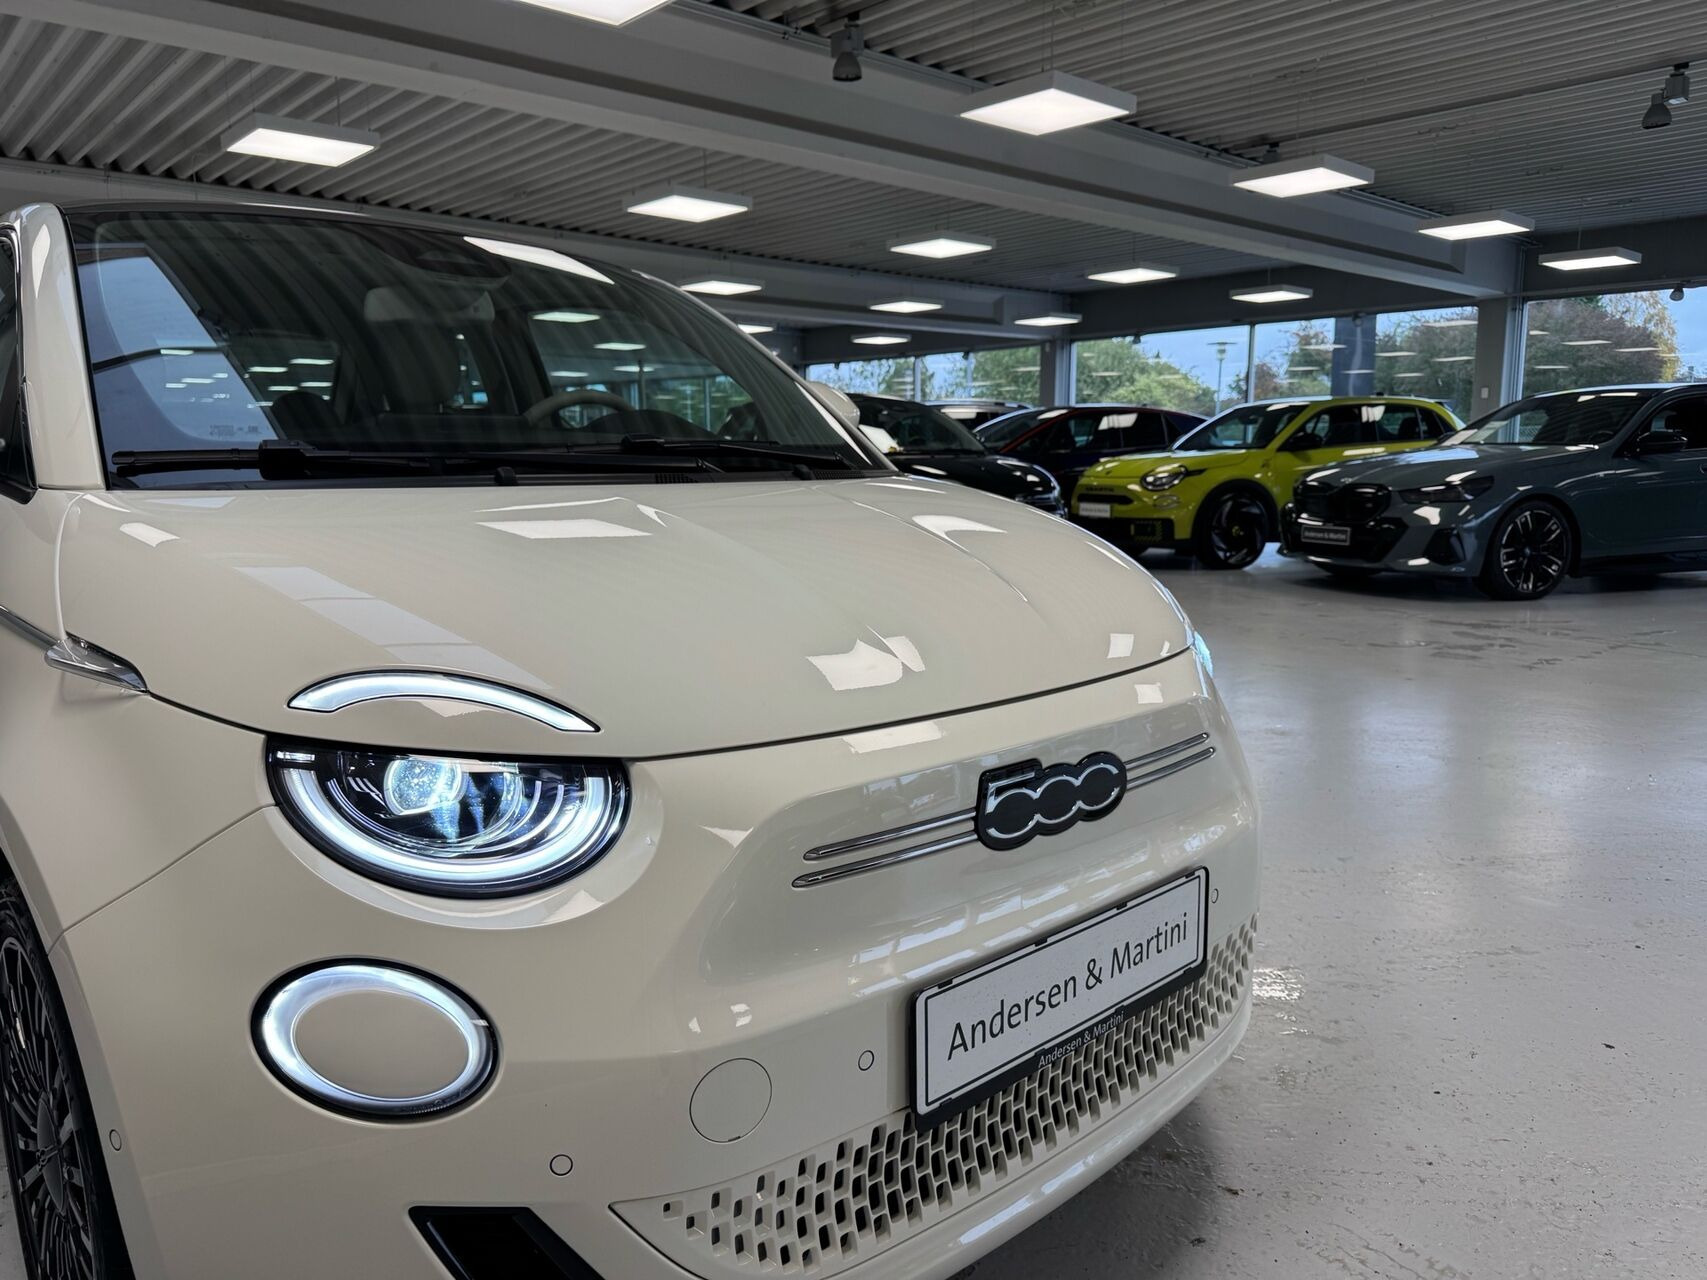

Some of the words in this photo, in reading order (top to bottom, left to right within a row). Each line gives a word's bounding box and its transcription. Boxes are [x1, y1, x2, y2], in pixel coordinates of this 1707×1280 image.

[983, 757, 1122, 842] 500
[947, 975, 1078, 1060] Andersen
[1085, 957, 1103, 991] &
[1110, 912, 1188, 979] Martini
[1038, 1037, 1082, 1069] Andersen
[1083, 1029, 1092, 1043] &
[1092, 1010, 1125, 1038] Martini
